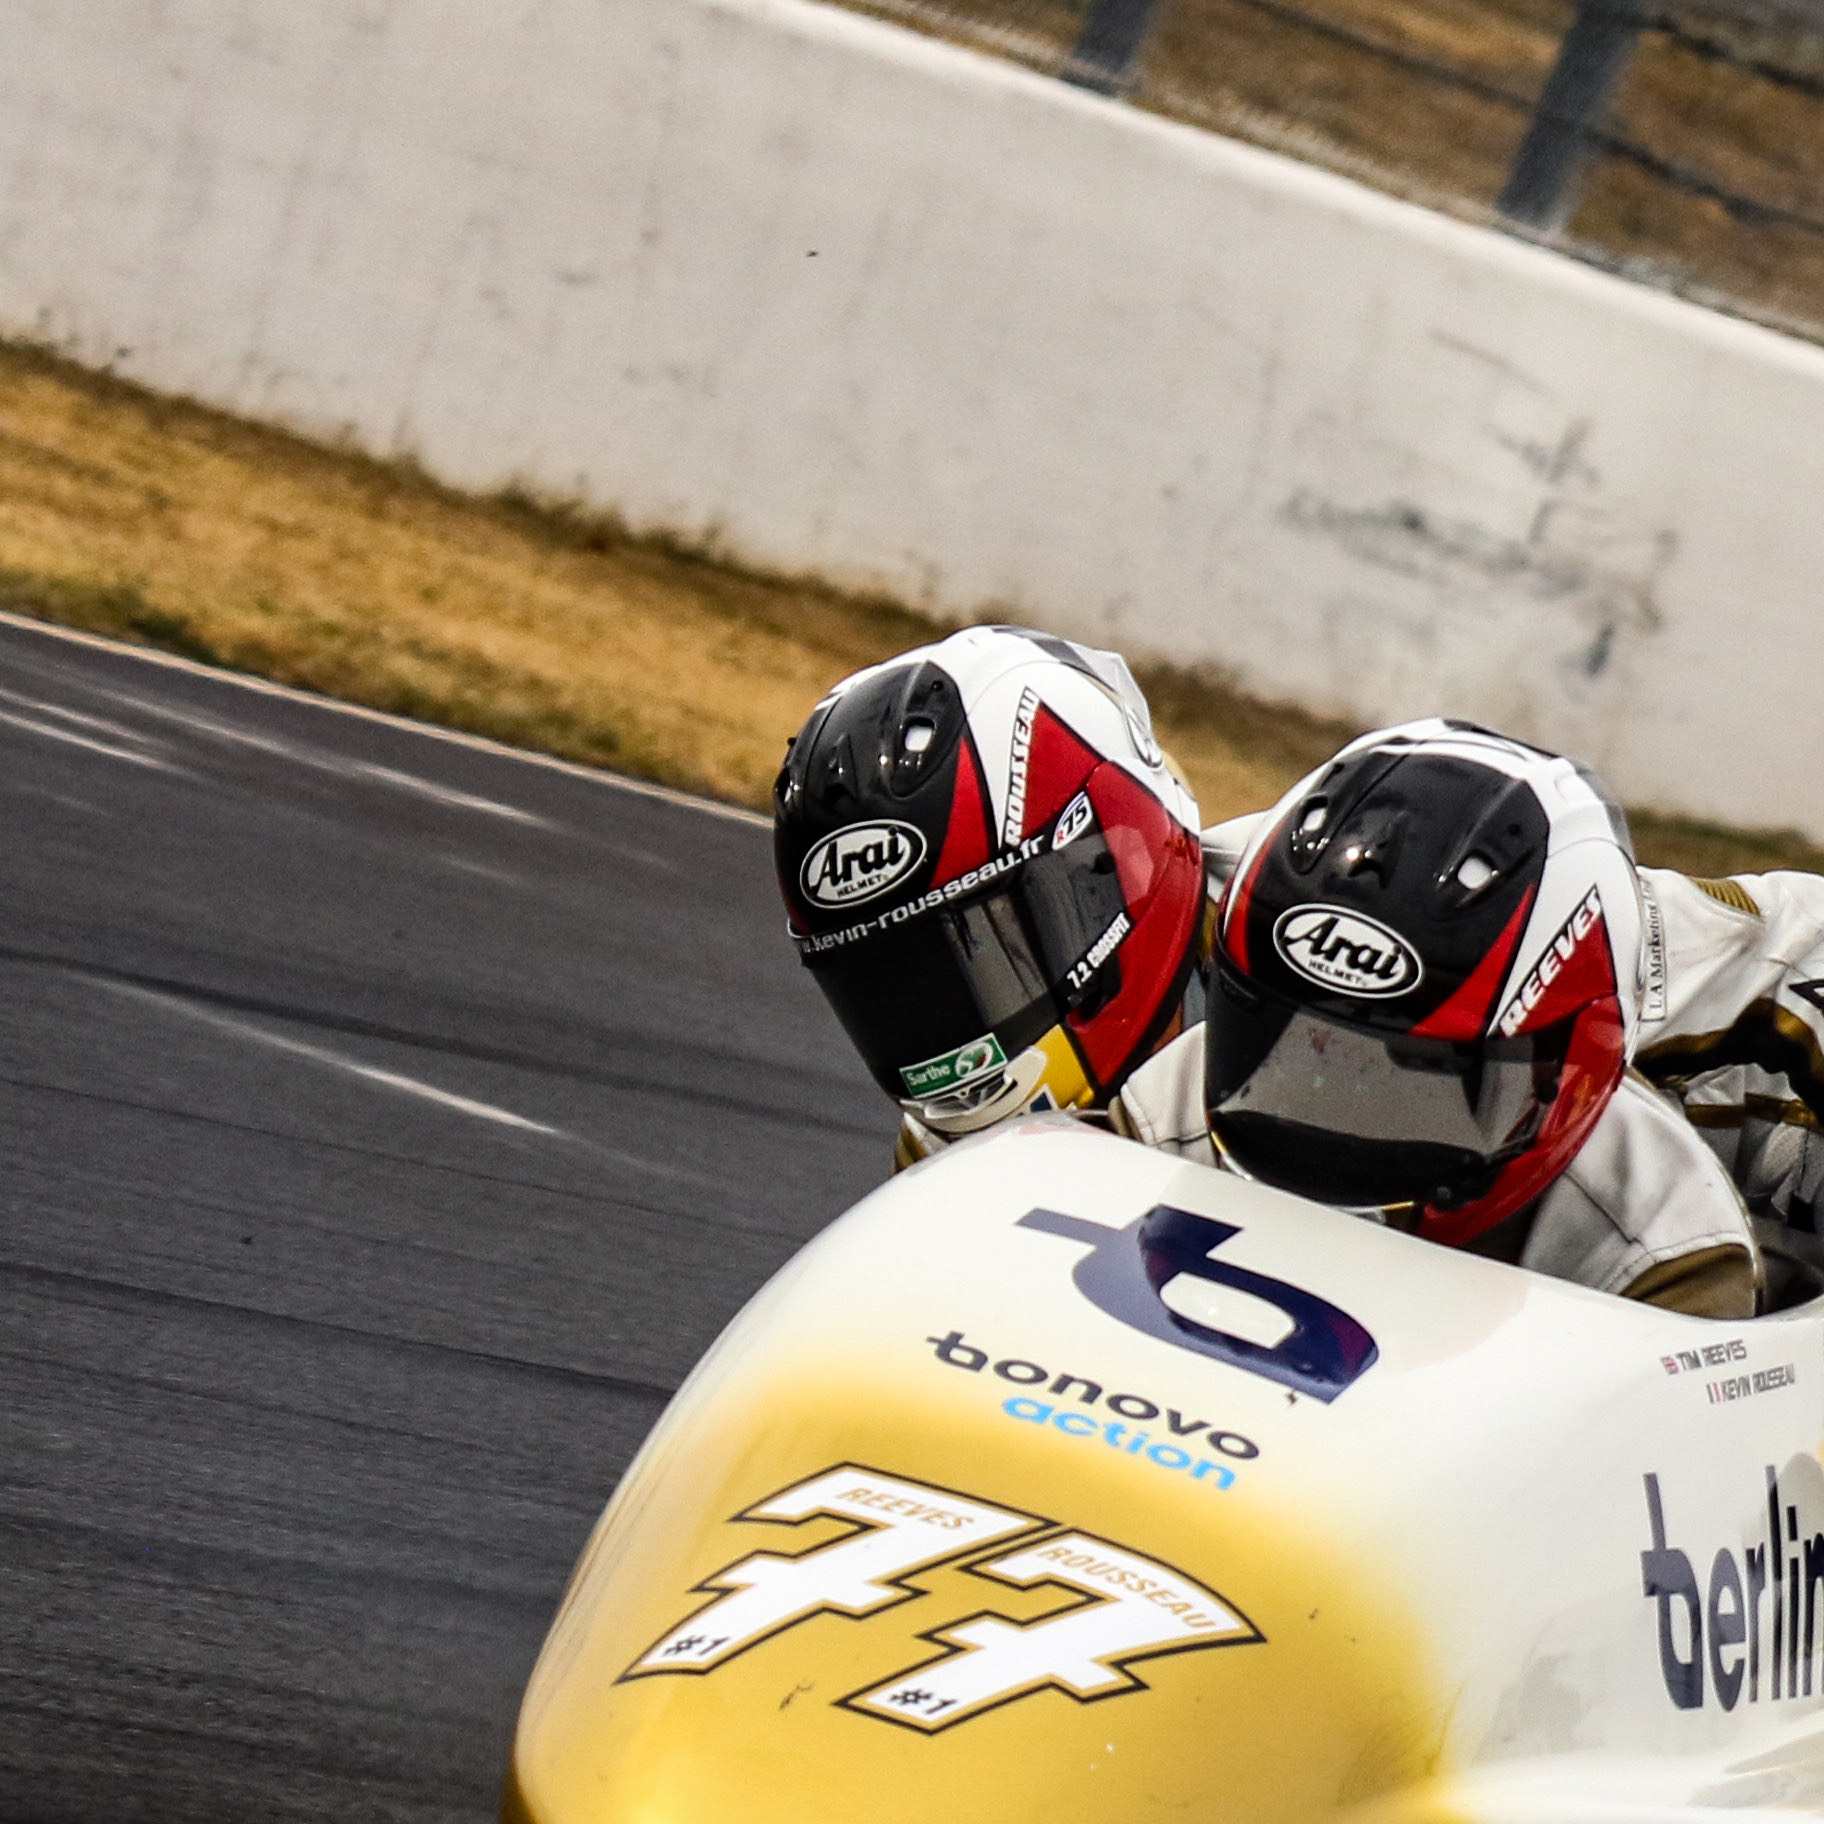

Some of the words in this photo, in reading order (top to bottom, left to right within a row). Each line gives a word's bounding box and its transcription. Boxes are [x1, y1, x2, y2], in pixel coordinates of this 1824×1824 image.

[1004, 686, 1041, 848] ROUSSEAU
[809, 826, 902, 896] Arai
[837, 877, 884, 898] HELMET
[1281, 916, 1400, 980] Arai
[1309, 958, 1368, 987] HELMET
[1500, 892, 1601, 1038] REEVES
[925, 1331, 1260, 1460] bonovo
[1001, 1396, 1238, 1491] action
[837, 1486, 974, 1531] REEVES
[613, 1461, 1268, 1736] 77
[1038, 1545, 1219, 1630] ROUSSEAU
[662, 1633, 732, 1658] #1
[889, 1688, 963, 1716] #1
